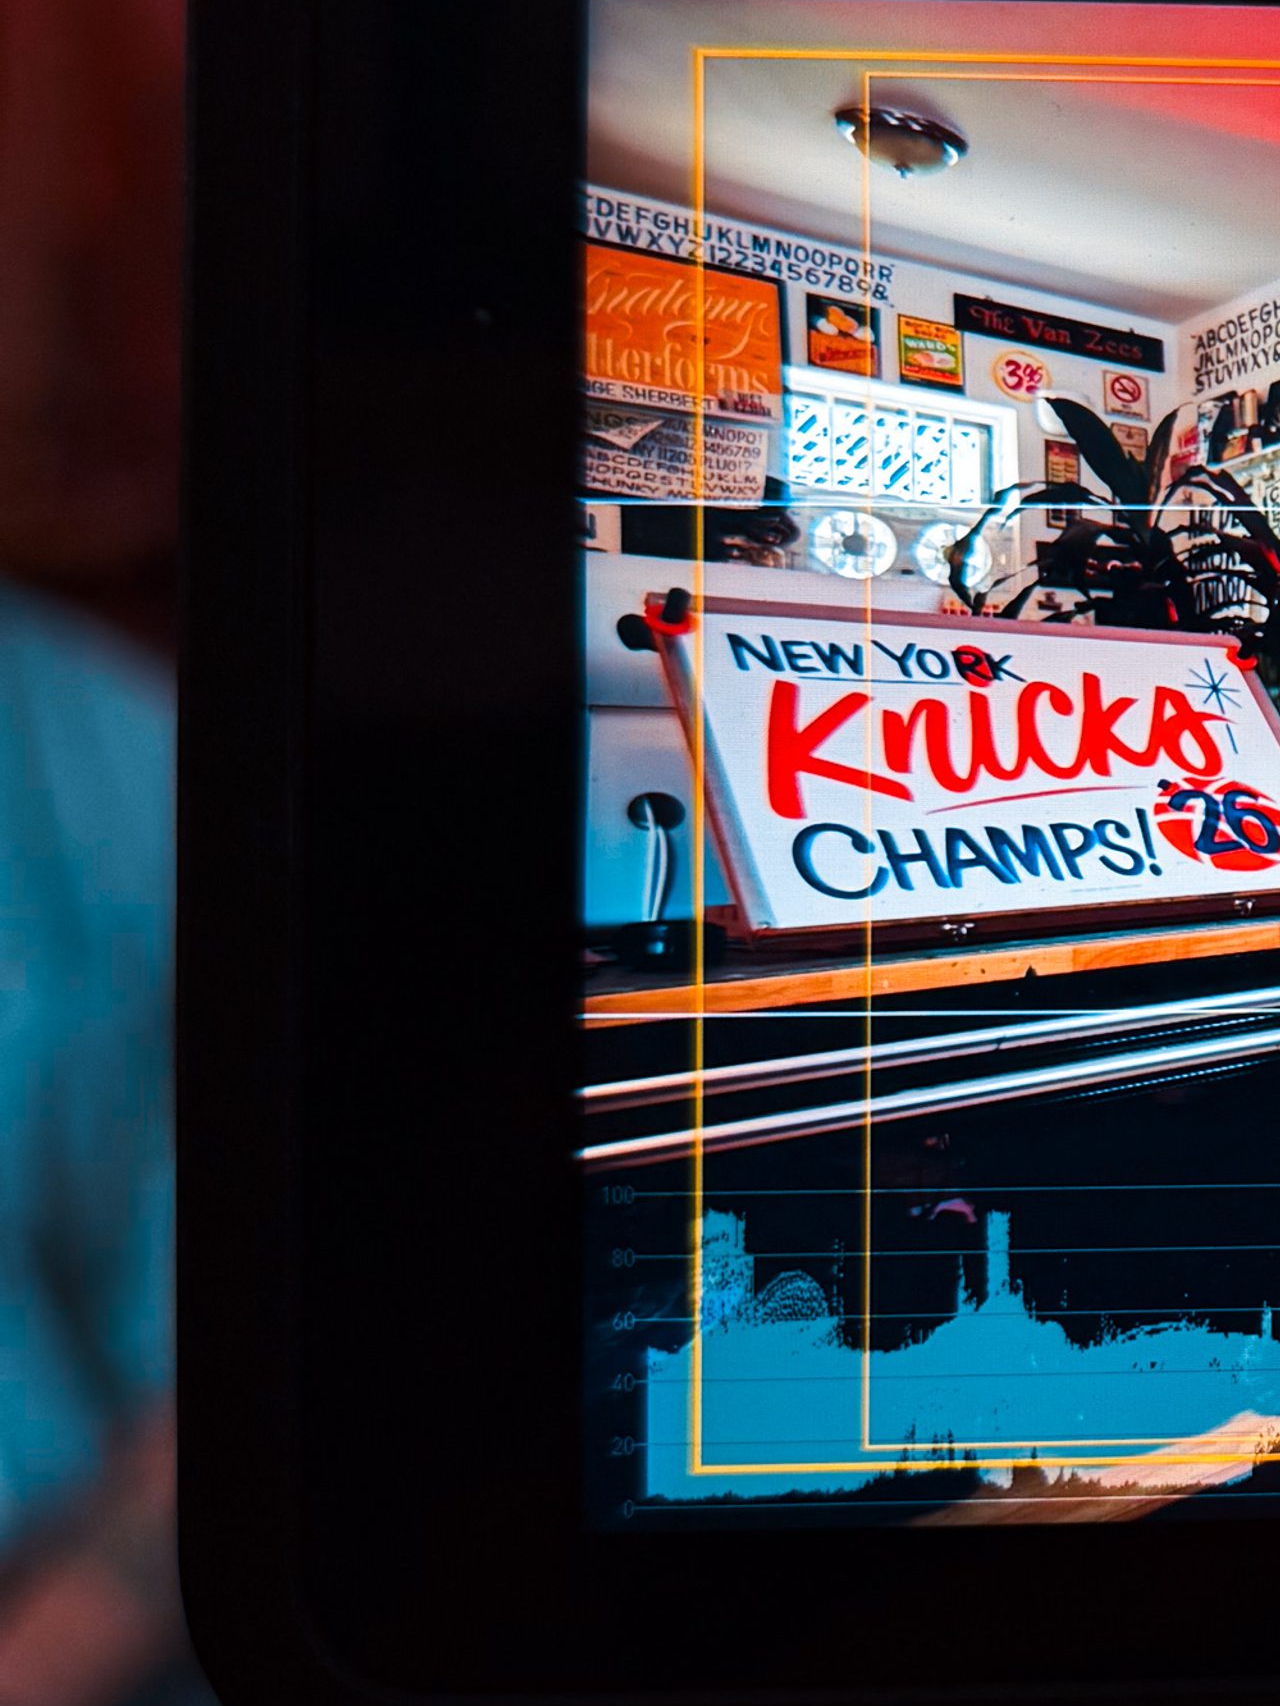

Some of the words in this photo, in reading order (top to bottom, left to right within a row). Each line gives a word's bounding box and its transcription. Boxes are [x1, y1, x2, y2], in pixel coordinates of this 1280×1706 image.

[1022, 315, 1072, 346] Van
[724, 632, 865, 678] NEW
[871, 636, 1028, 685] YORK
[766, 672, 1236, 821] Knicks
[791, 807, 1164, 900] CHAMPS!
[602, 1185, 634, 1204] 100
[612, 1248, 635, 1267] 80
[612, 1311, 635, 1330] 60
[610, 1372, 635, 1392] 40
[610, 1436, 635, 1455] 20
